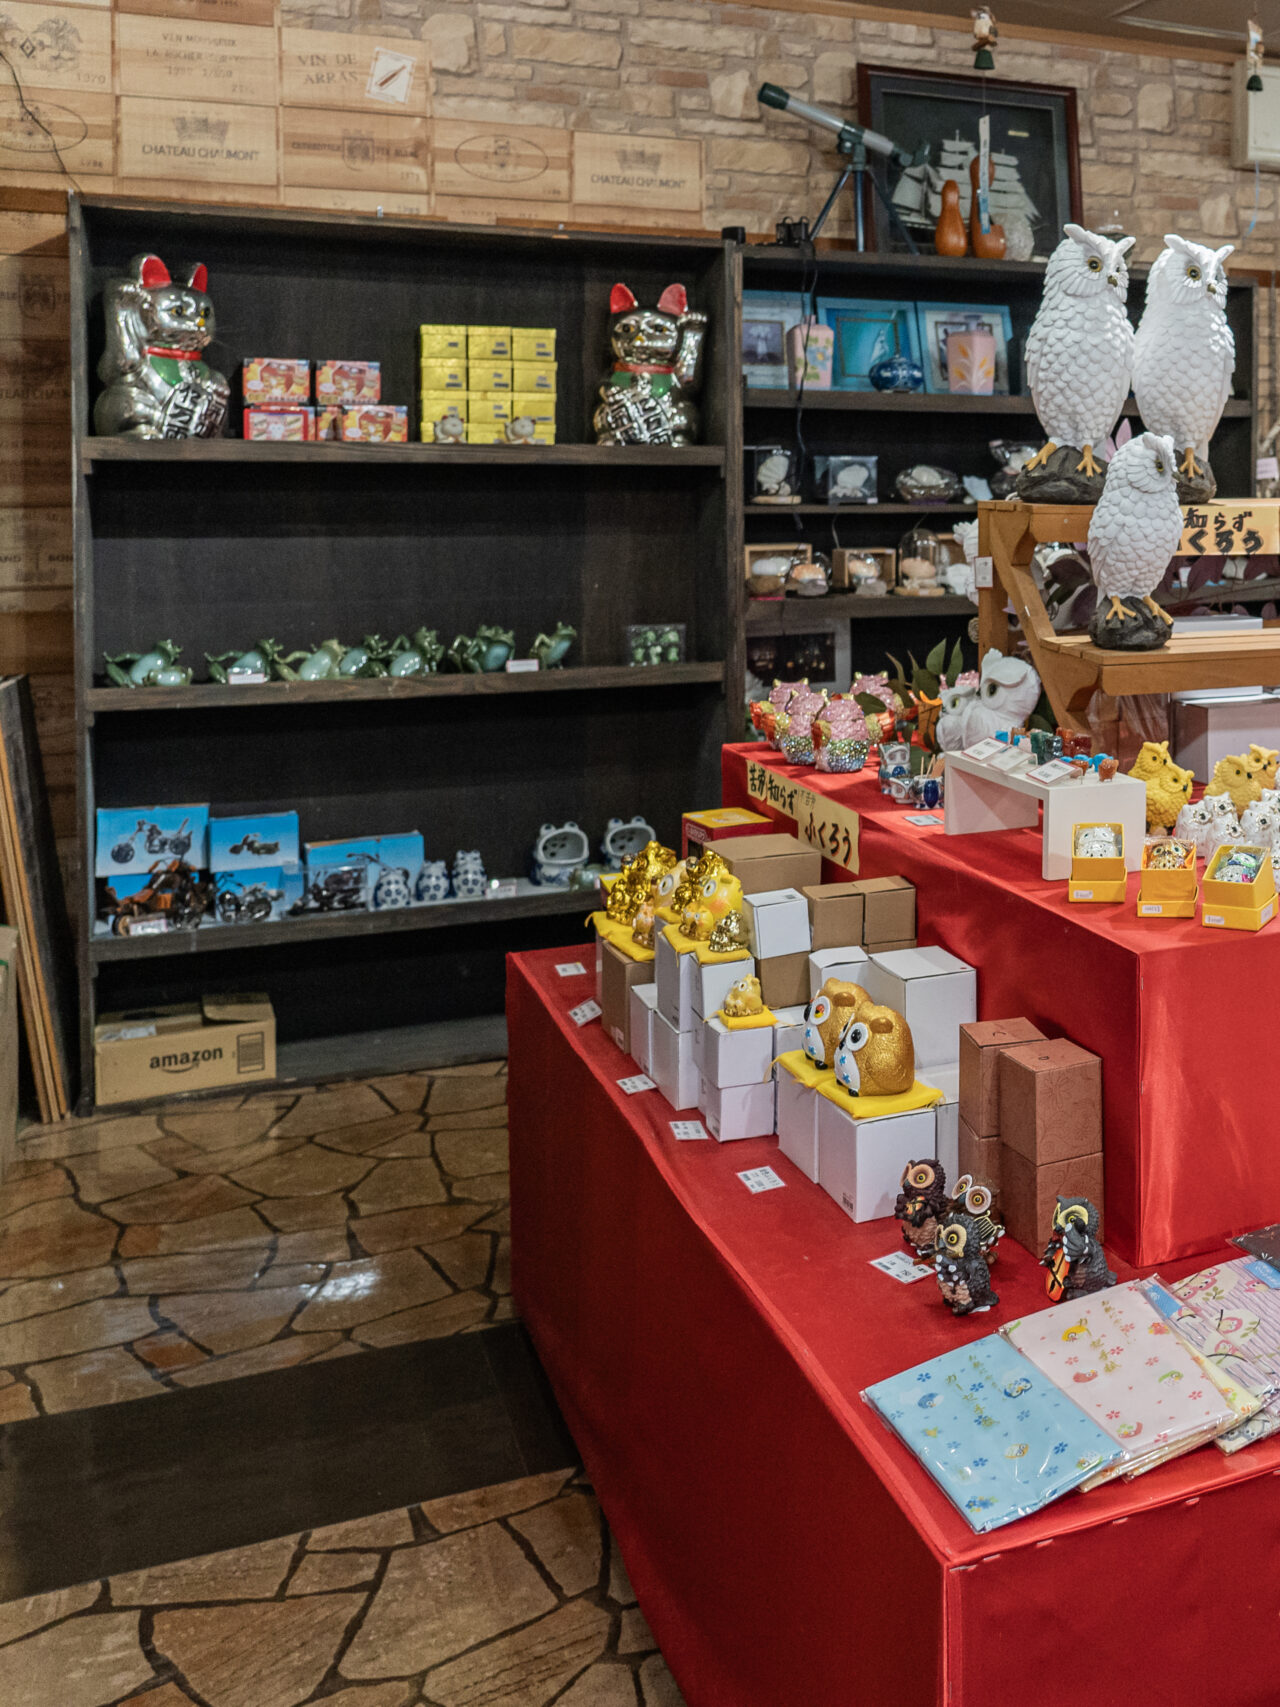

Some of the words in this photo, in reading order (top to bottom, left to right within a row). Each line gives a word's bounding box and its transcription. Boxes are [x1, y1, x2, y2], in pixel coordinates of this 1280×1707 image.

[297, 54, 327, 66] VIN
[335, 54, 357, 65] DE
[142, 144, 196, 158] CHATEAU
[591, 174, 634, 187] CHATEAU
[1178, 529, 1264, 555] くろう
[804, 811, 852, 866] ふくろう
[149, 1047, 223, 1069] amazon
